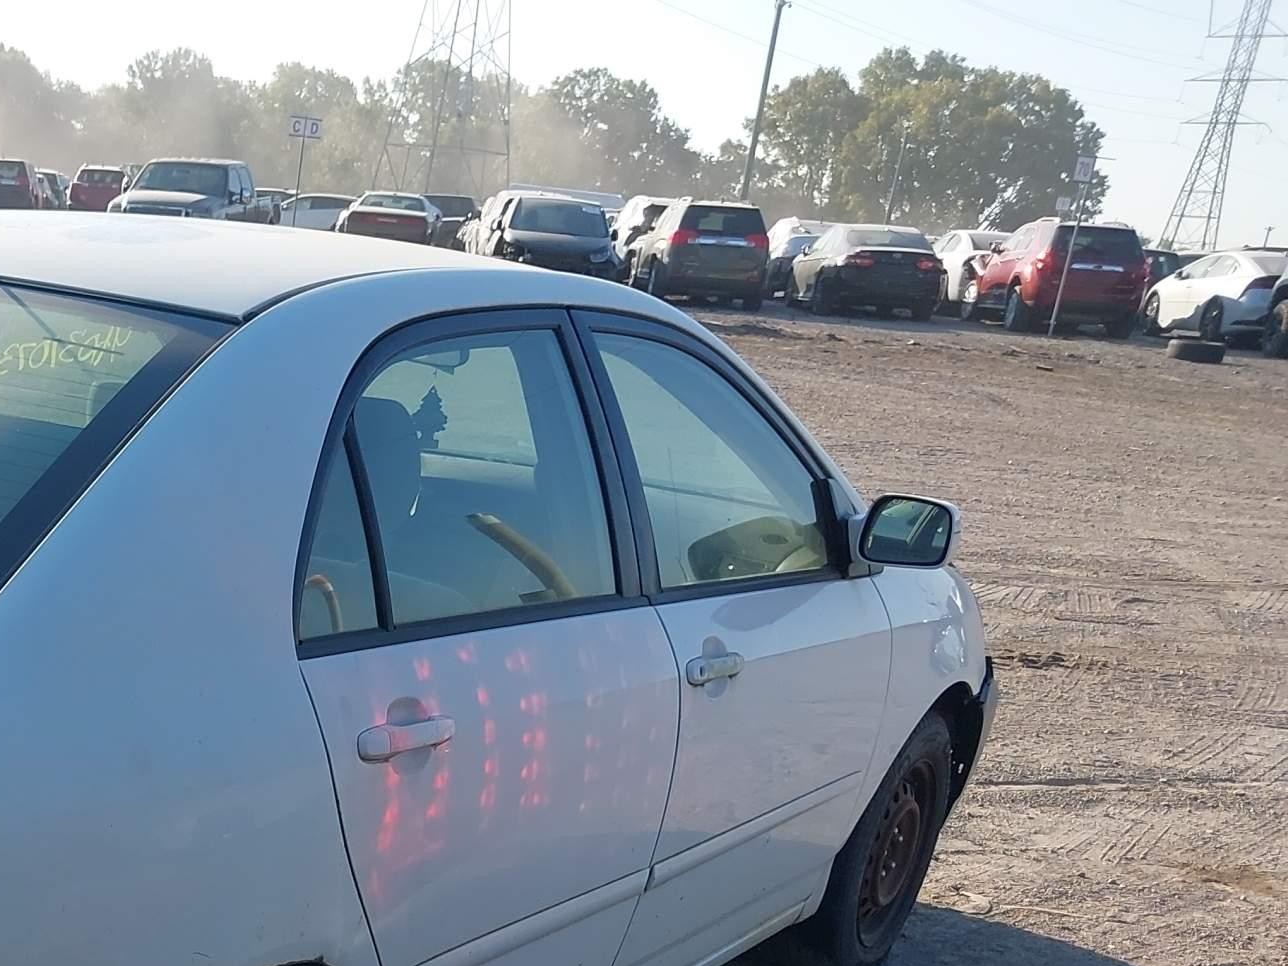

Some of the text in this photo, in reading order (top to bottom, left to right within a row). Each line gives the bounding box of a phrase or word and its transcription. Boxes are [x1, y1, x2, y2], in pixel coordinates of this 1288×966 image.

[292, 120, 319, 135] C D
[1078, 160, 1091, 177] 70
